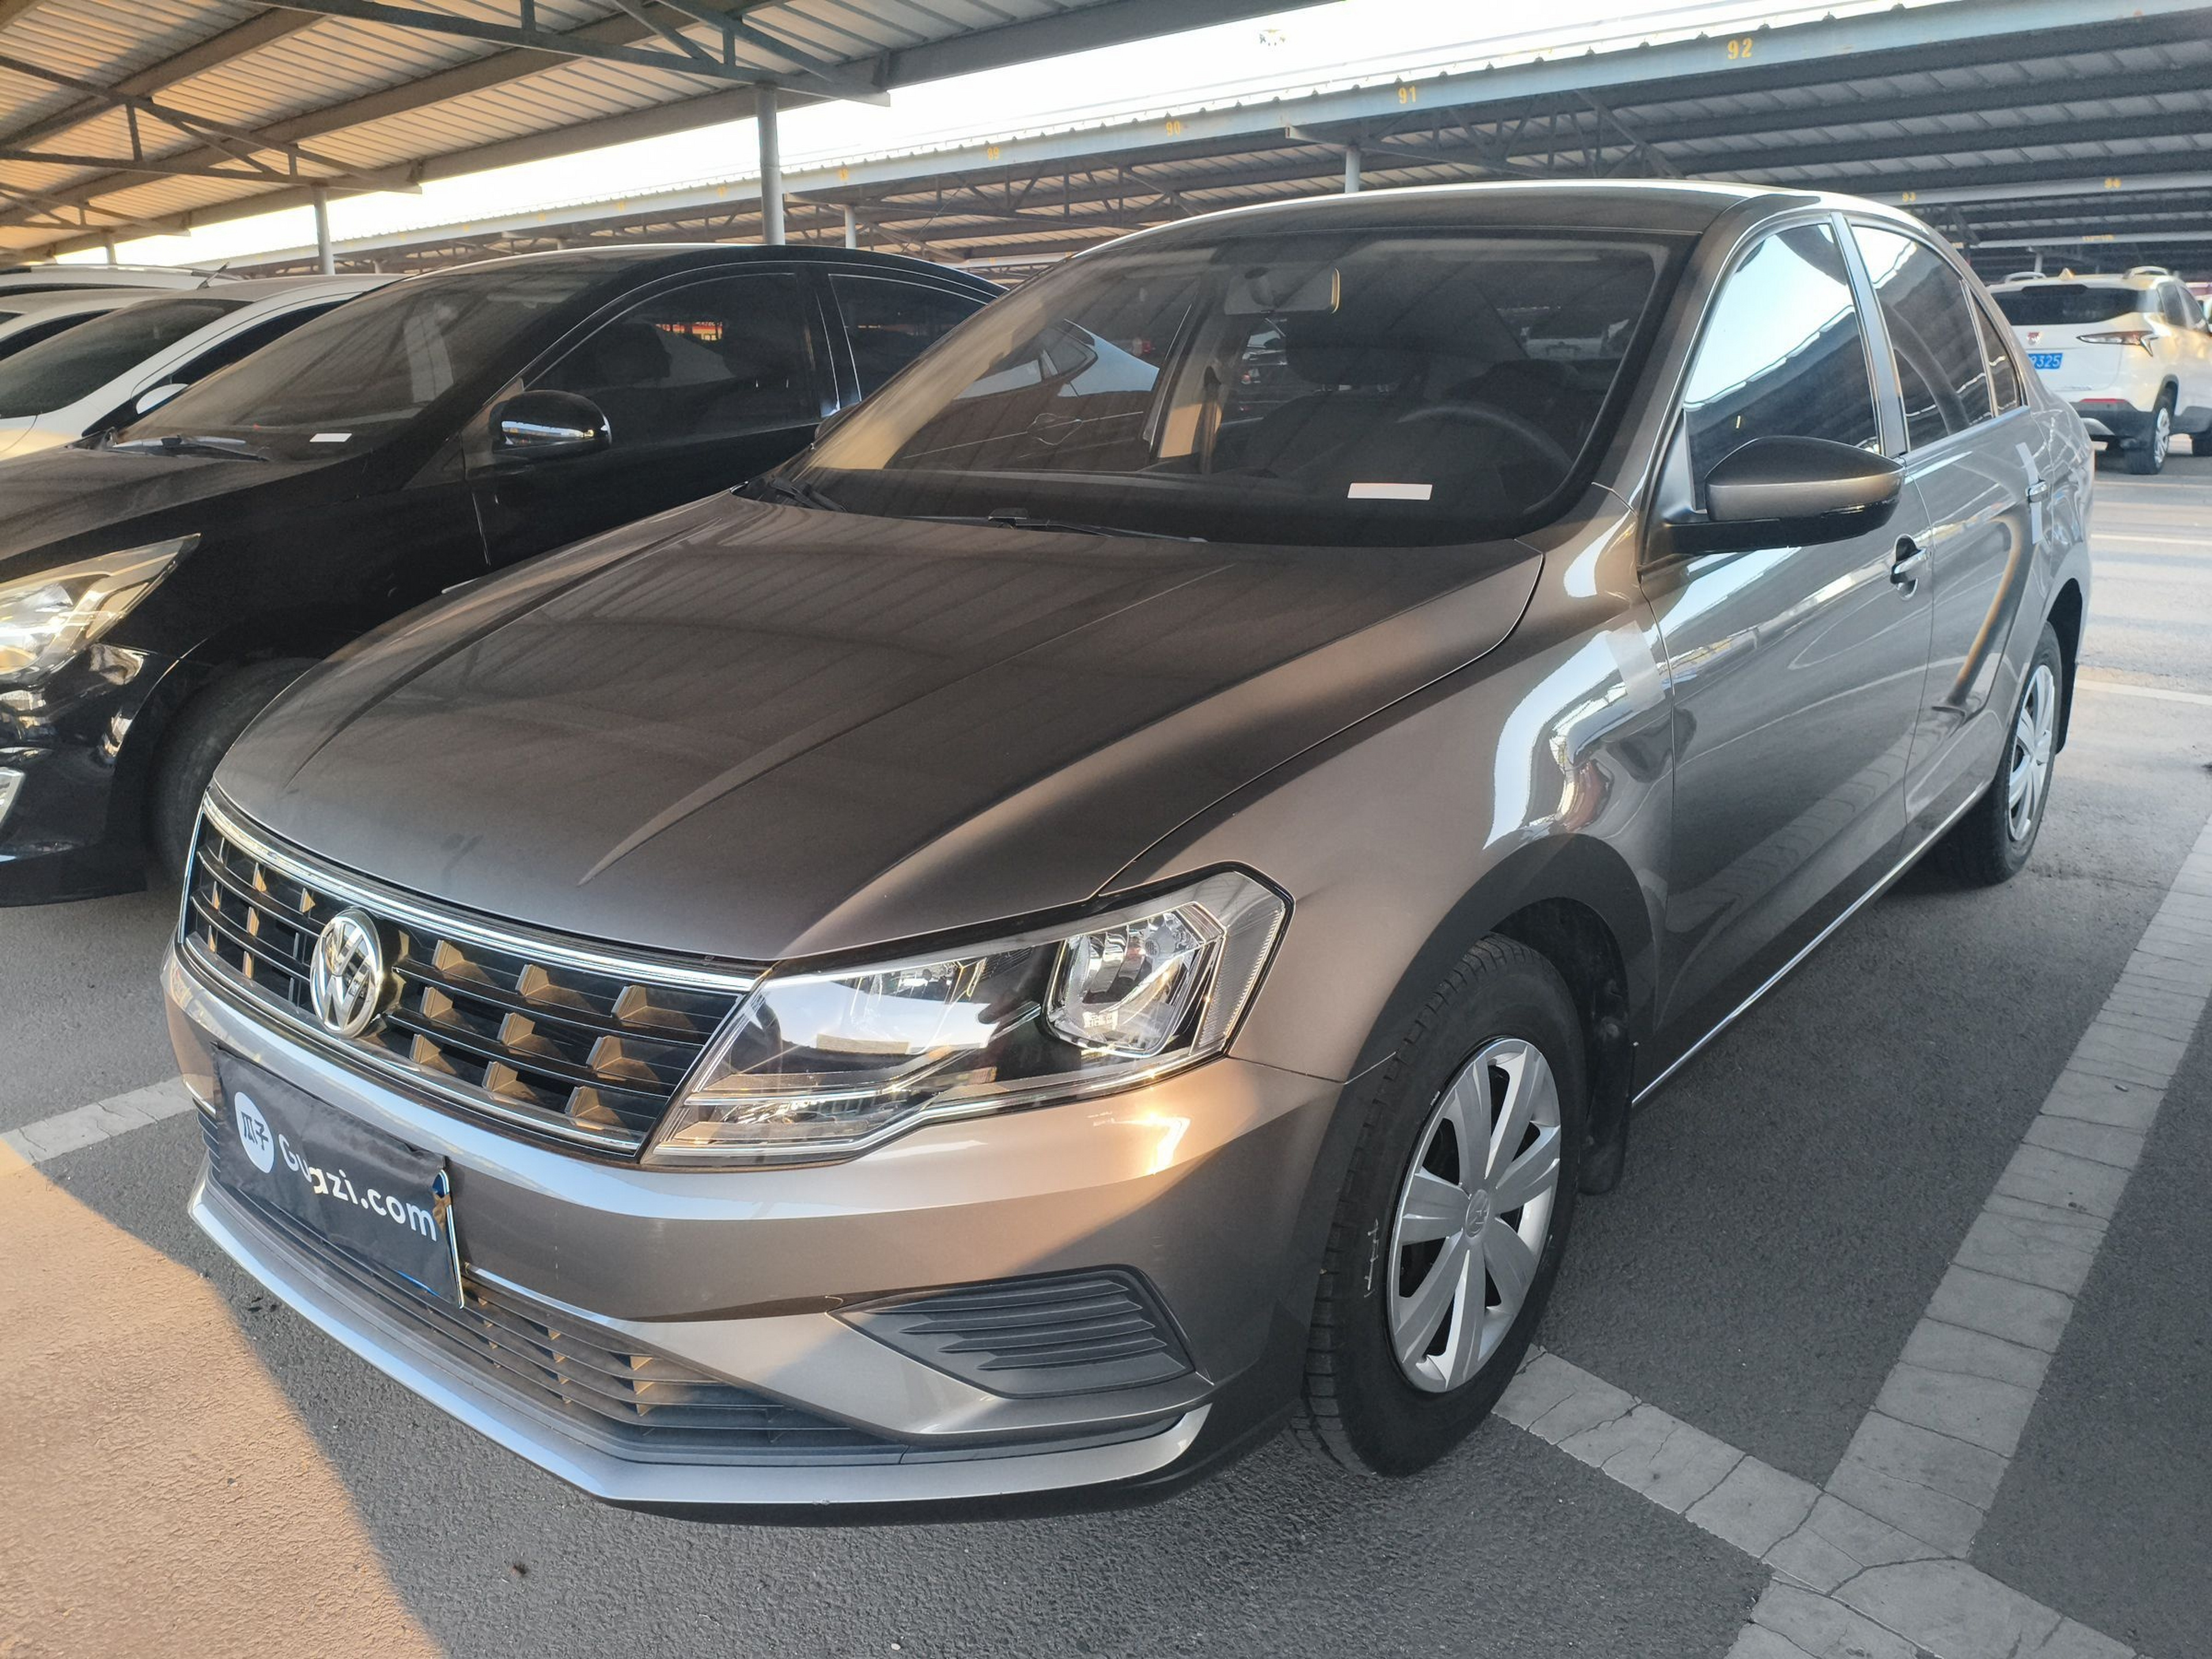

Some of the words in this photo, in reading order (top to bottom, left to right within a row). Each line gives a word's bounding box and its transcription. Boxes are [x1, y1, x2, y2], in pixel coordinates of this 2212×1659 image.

[1728, 38, 1752, 59] 92
[1398, 86, 1416, 104] 91
[1166, 120, 1180, 137] 90
[240, 1111, 269, 1151] 瓜子
[278, 1134, 437, 1242] Guazi.com
